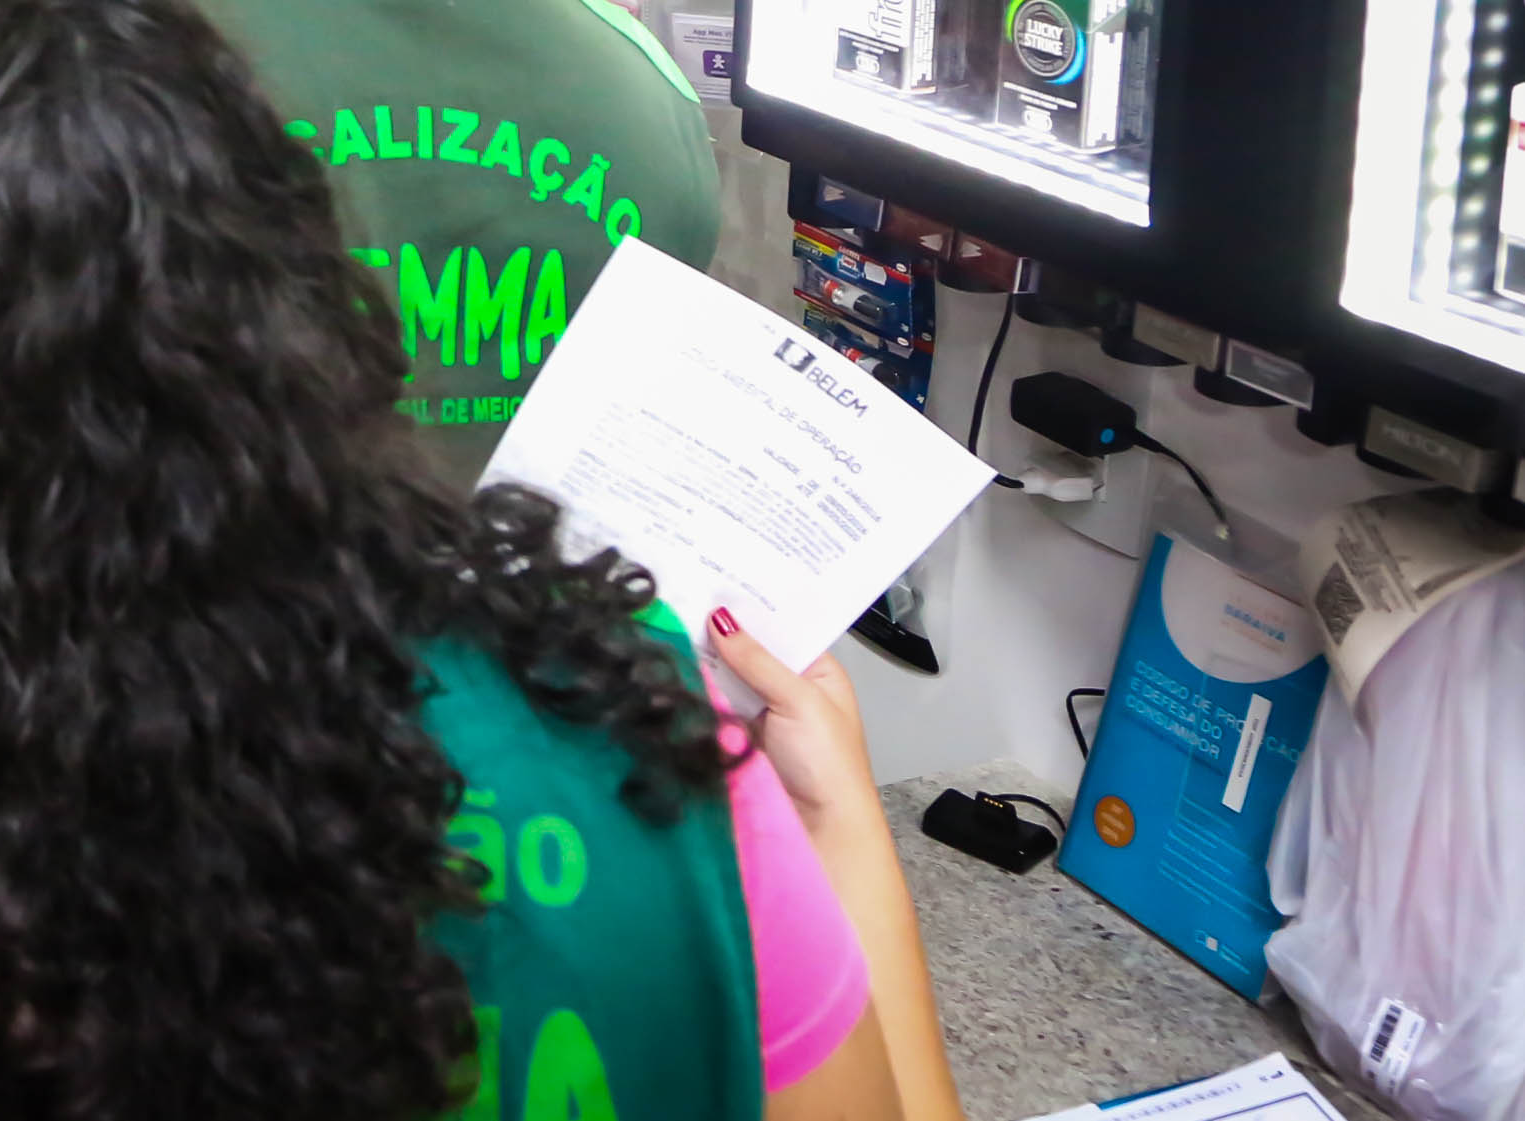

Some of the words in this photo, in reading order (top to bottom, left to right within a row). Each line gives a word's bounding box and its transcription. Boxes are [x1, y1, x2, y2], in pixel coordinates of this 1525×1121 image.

[1026, 19, 1063, 38] LUCKY
[1021, 34, 1063, 57] STRIKE
[441, 398, 470, 425] DE
[1200, 719, 1223, 741] DO
